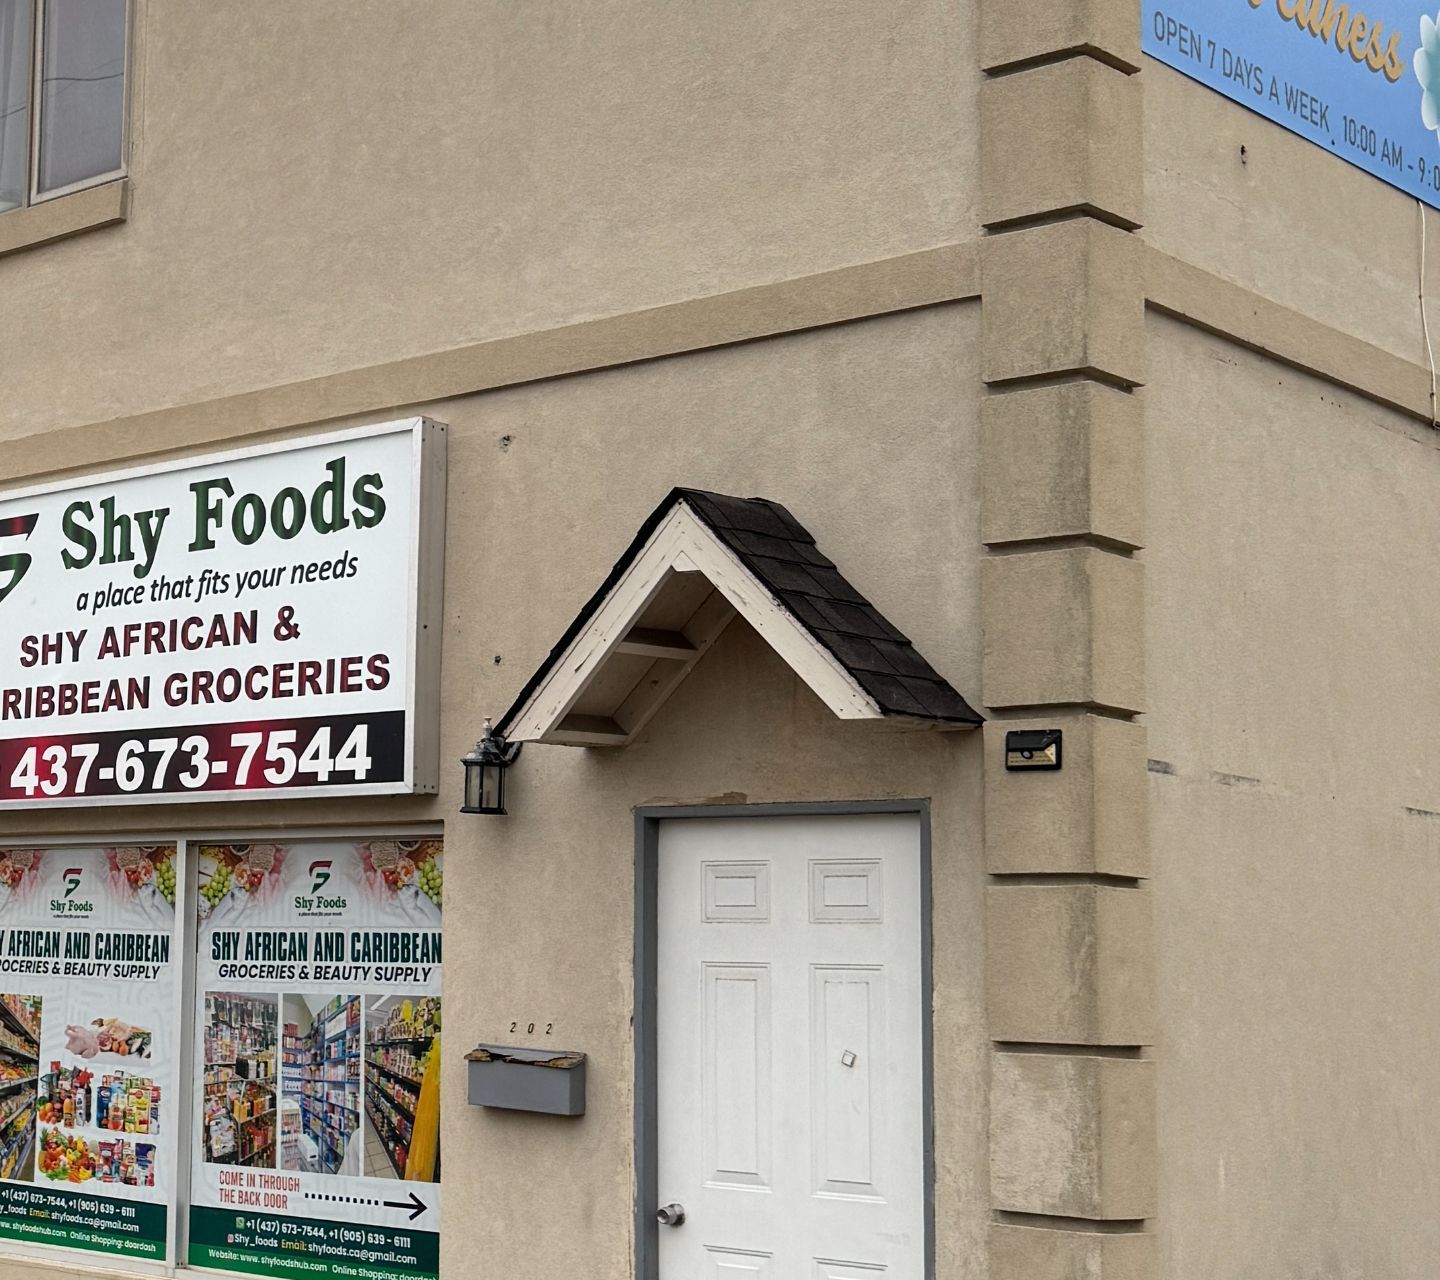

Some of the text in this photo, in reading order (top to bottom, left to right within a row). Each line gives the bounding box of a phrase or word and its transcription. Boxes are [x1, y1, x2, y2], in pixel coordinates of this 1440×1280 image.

[1154, 10, 1202, 64] OPEN
[1207, 39, 1216, 70] 7
[1222, 47, 1263, 96] DAYS
[1268, 75, 1280, 106] A
[1284, 81, 1330, 133] WEEK
[1342, 115, 1377, 158] 10:00
[1381, 137, 1403, 172] AM
[60, 456, 387, 579] Shy Foods
[76, 550, 359, 616] a place that fits your needs
[19, 605, 301, 668] SHY AFRICAN &
[163, 653, 391, 708] GROCERIES
[10, 724, 373, 797] 437-673-7544
[50, 900, 93, 914] Shy Foods
[294, 895, 347, 911] Shy Foods
[8, 929, 60, 959] AFRICAN
[64, 931, 90, 960] AND
[95, 932, 170, 963] CARIBBEAN
[212, 931, 442, 963] SHY AFRICAN AND CARIBBEAN
[51, 961, 60, 975] &
[64, 961, 111, 978] BEAUTY
[113, 964, 160, 980] SUPPLY
[219, 964, 432, 983] GROCERIES & BEAUTY SUPPLY
[510, 1022, 553, 1034] 202
[219, 1170, 300, 1193] COME IN THROUGH
[2, 1190, 10, 1200] +1
[10, 1189, 30, 1205] (437)
[30, 1194, 67, 1209] 673-7544,
[69, 1199, 77, 1209] +1
[77, 1198, 99, 1214] (905)
[100, 1204, 114, 1215] 639
[121, 1206, 135, 1218] 6111
[219, 1188, 288, 1209] THE BACK DOOR
[29, 1207, 50, 1220] Email:
[51, 1211, 140, 1233] shyfoods.ca@gmail.com
[246, 1220, 255, 1230] +1
[256, 1218, 280, 1235] (437)
[281, 1222, 327, 1240] 673-7544,
[329, 1229, 338, 1239] +1
[340, 1228, 365, 1245] (905)
[367, 1233, 385, 1245] 639
[394, 1236, 411, 1248] 6111
[12, 1221, 67, 1238] shyfoodshub.com
[70, 1231, 90, 1242] Online
[91, 1233, 124, 1249] Shopping:
[124, 1239, 156, 1252] doordash
[234, 1234, 417, 1265] Shy_foods Email: shyfoods.ca@gmail.com
[208, 1248, 239, 1261] Website:
[240, 1253, 260, 1263] www.
[261, 1256, 327, 1273] shyfoodshub.com
[332, 1264, 357, 1277] Online
